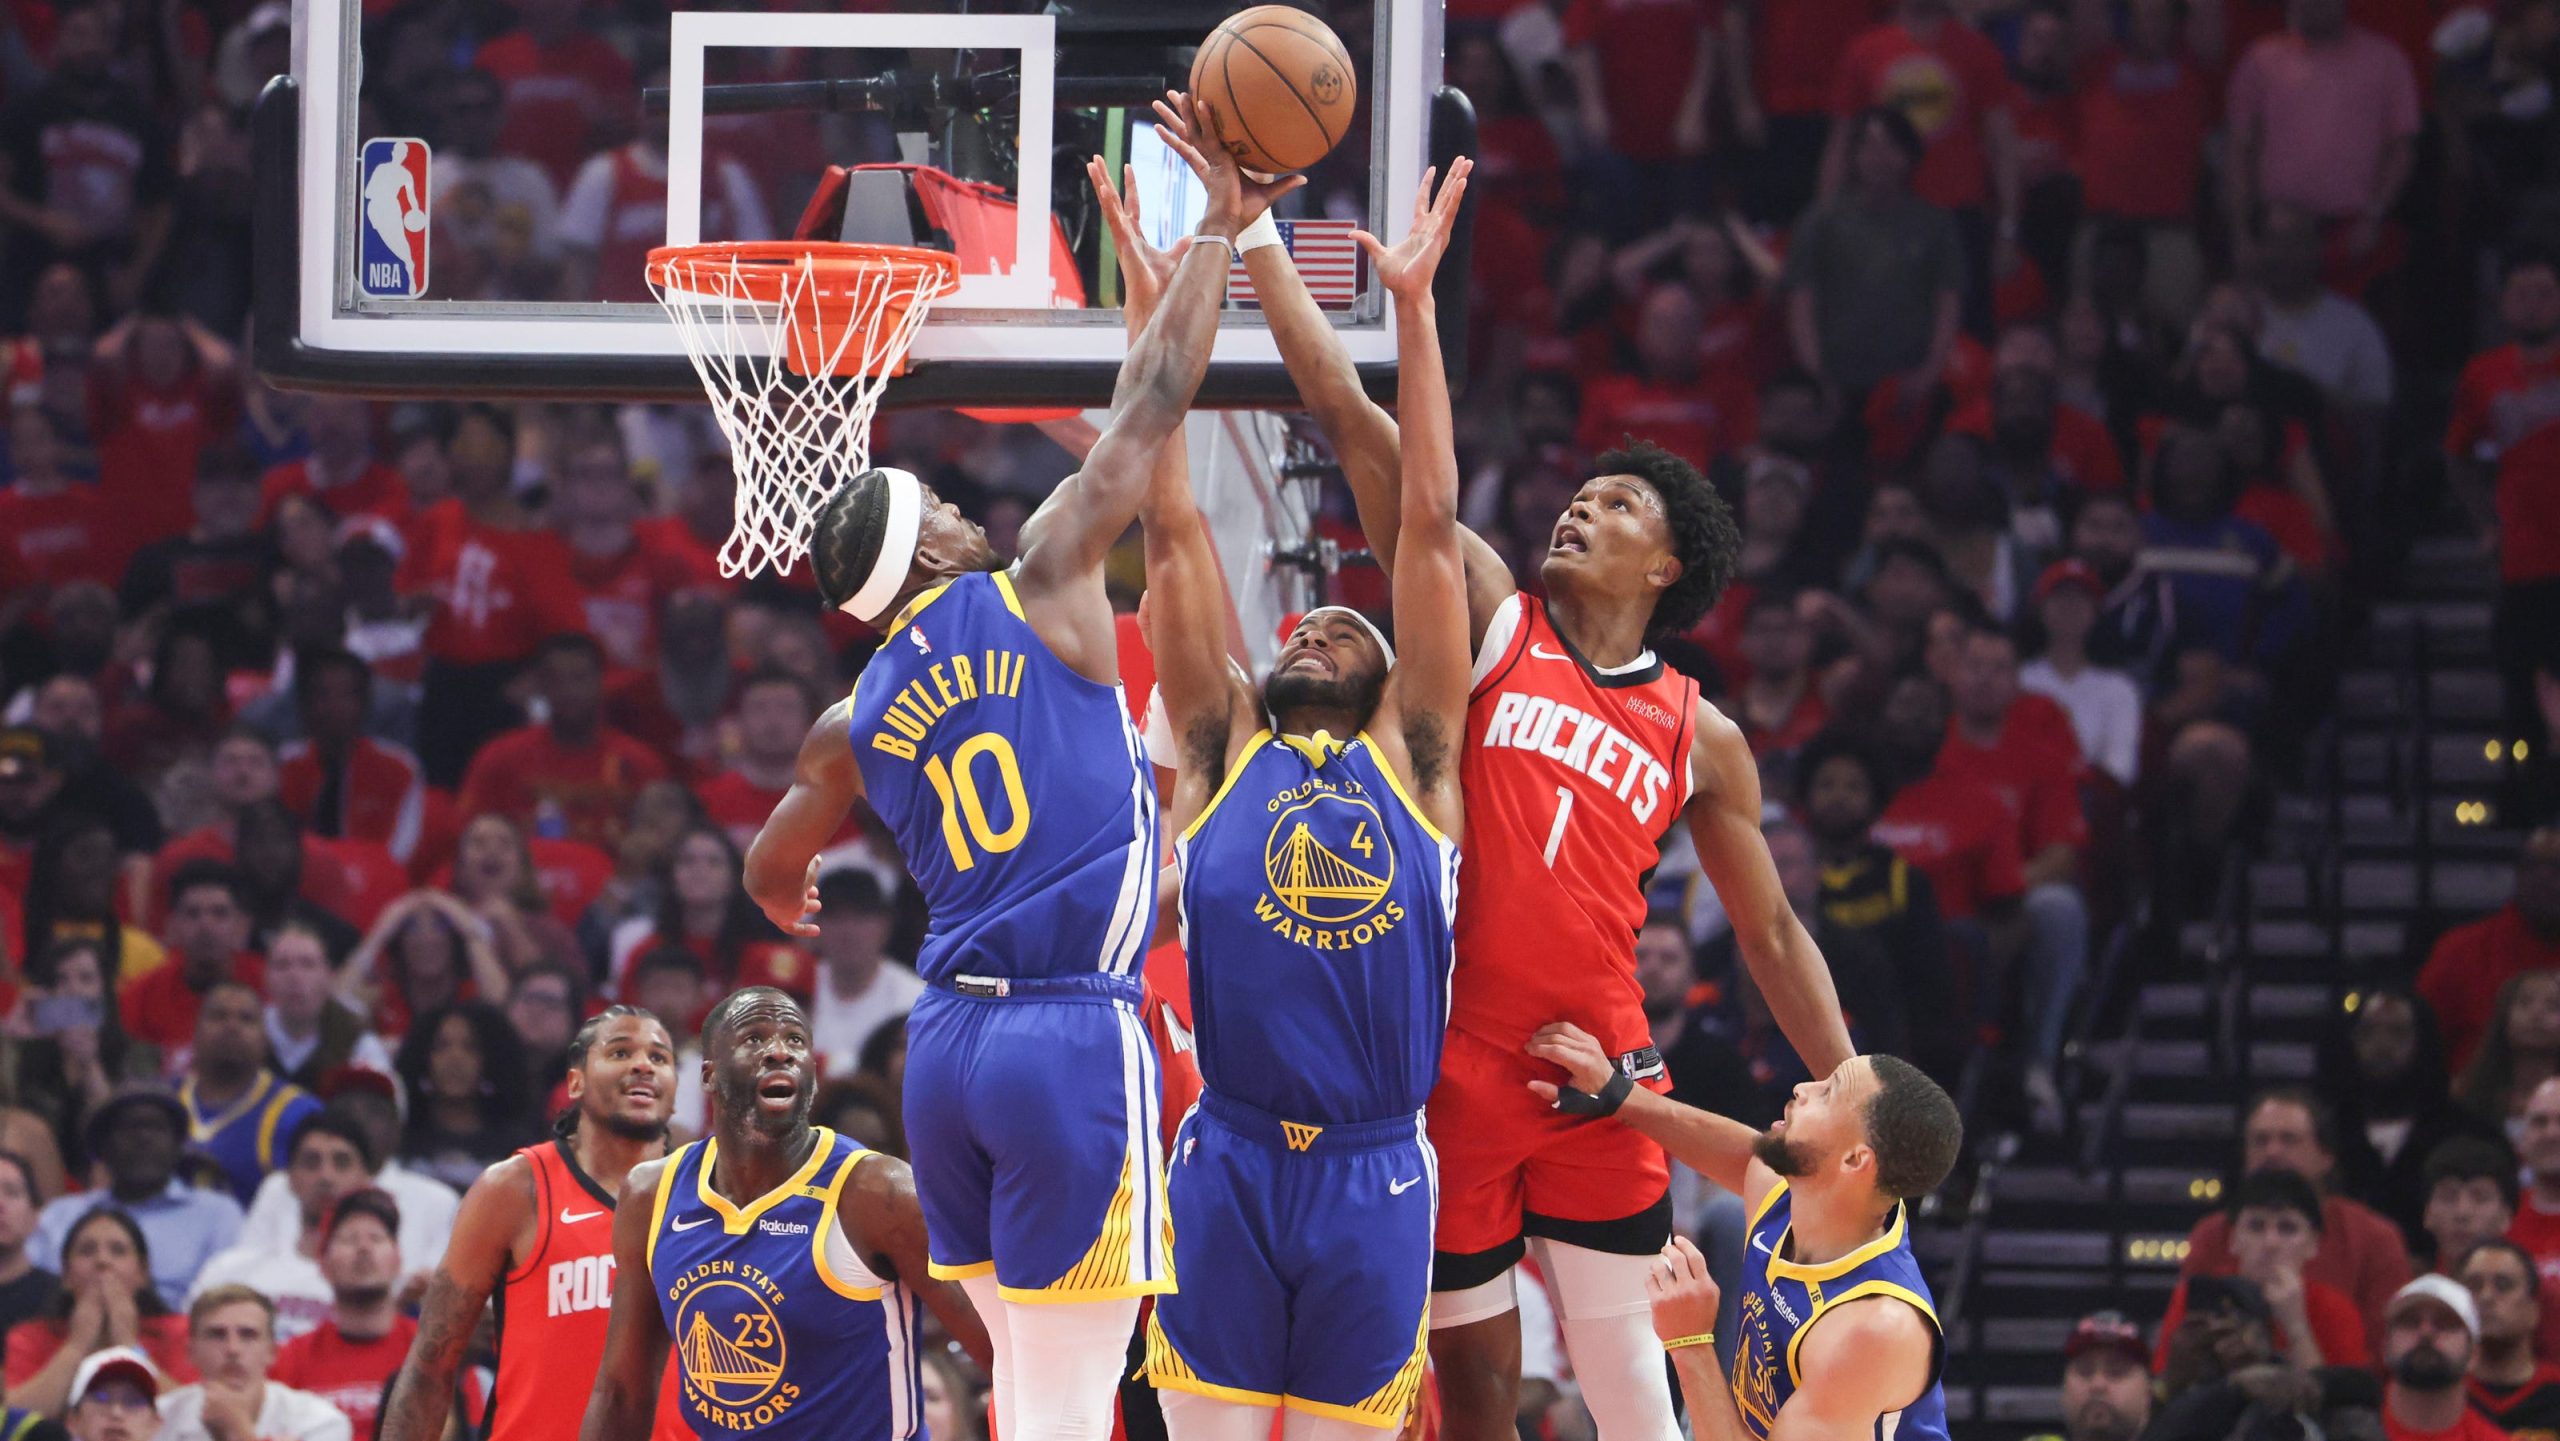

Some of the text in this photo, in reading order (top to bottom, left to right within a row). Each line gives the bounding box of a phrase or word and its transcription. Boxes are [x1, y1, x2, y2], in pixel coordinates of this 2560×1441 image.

[369, 263, 401, 288] NBA
[872, 650, 1025, 761] BUTLER III
[1626, 701, 1675, 730] HERMANN
[1628, 695, 1676, 722] MEMORIAL
[1483, 692, 1670, 825] ROCKETS
[923, 732, 1030, 872] 10
[1268, 779, 1337, 812] GOLDEN
[1351, 822, 1374, 859] 4
[1544, 786, 1574, 870] 1
[1254, 893, 1405, 950] WARRIORS
[759, 1219, 809, 1235] Rakuten
[548, 1254, 617, 1318] ROC
[670, 1261, 785, 1305] GOLDEN STATE
[1810, 1289, 1821, 1303] 16
[1771, 1286, 1801, 1329] Rakuten
[734, 1313, 774, 1348] 23
[683, 1378, 800, 1431] WARRIORS
